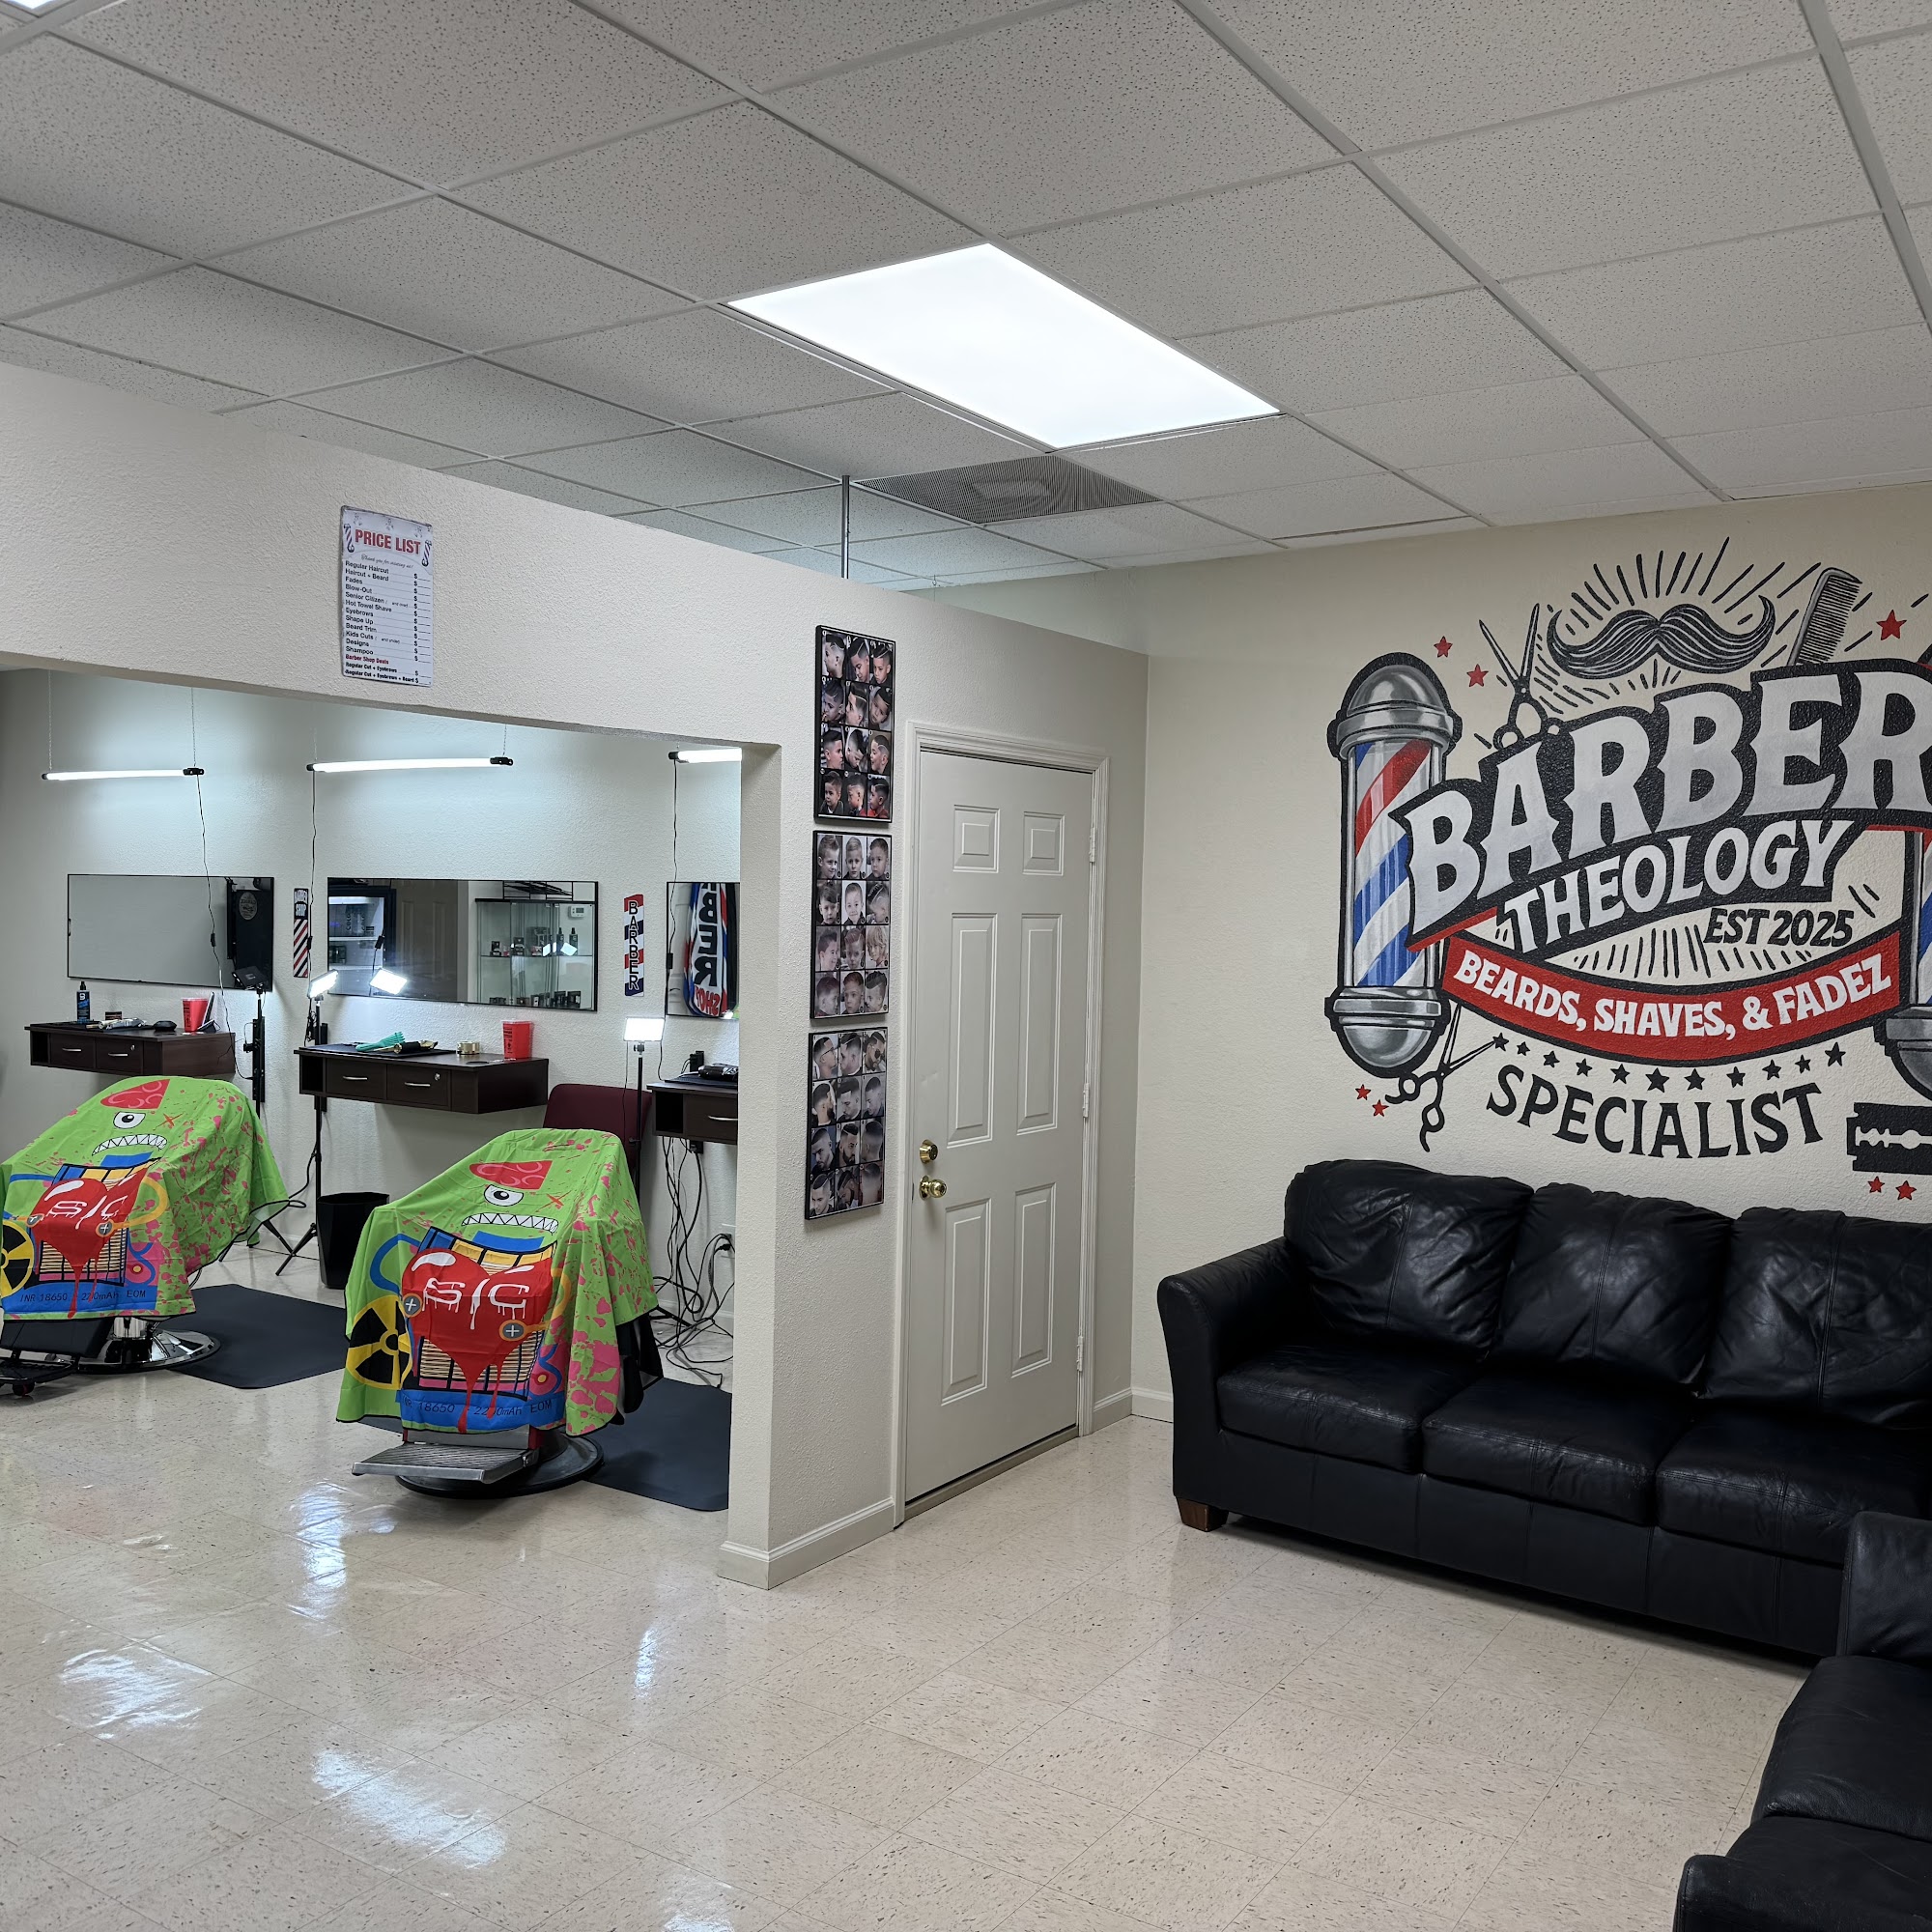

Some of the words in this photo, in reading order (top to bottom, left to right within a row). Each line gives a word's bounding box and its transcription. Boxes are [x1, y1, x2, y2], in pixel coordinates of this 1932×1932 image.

[355, 529, 391, 549] PRICE
[395, 537, 421, 554] LIST
[346, 560, 367, 569] Regular
[368, 565, 389, 574] Haircut
[346, 568, 366, 578] Haircut
[372, 573, 389, 582] Beard
[346, 576, 363, 584] Fades
[346, 583, 372, 594] Blow-Out
[346, 591, 363, 600] Senior
[365, 595, 384, 604] Citizen
[346, 608, 374, 616] Eyebrows
[375, 604, 392, 612] Shave
[346, 614, 364, 623] Shape
[346, 622, 363, 631] Beard
[360, 632, 374, 640] Cuts
[346, 639, 369, 647] Designs
[346, 646, 374, 655] Shampoo
[1405, 670, 1932, 937] BARBER
[1504, 819, 1855, 955] THEOLOGY
[1703, 908, 1774, 946] EST
[1768, 909, 1855, 948] 2025
[629, 901, 639, 991] BARBER
[1453, 951, 1588, 1032] BEARDS,
[1594, 998, 1737, 1041] SHAVES,
[1742, 995, 1774, 1031] &
[1774, 953, 1891, 1025] FADEZ
[1486, 1064, 1824, 1159] SPECIALIST
[40, 1293, 68, 1301] 18650
[81, 1292, 119, 1301] 220mAh
[127, 1290, 146, 1298] EOM
[418, 1402, 456, 1413] 18650
[530, 1399, 553, 1413] EOM
